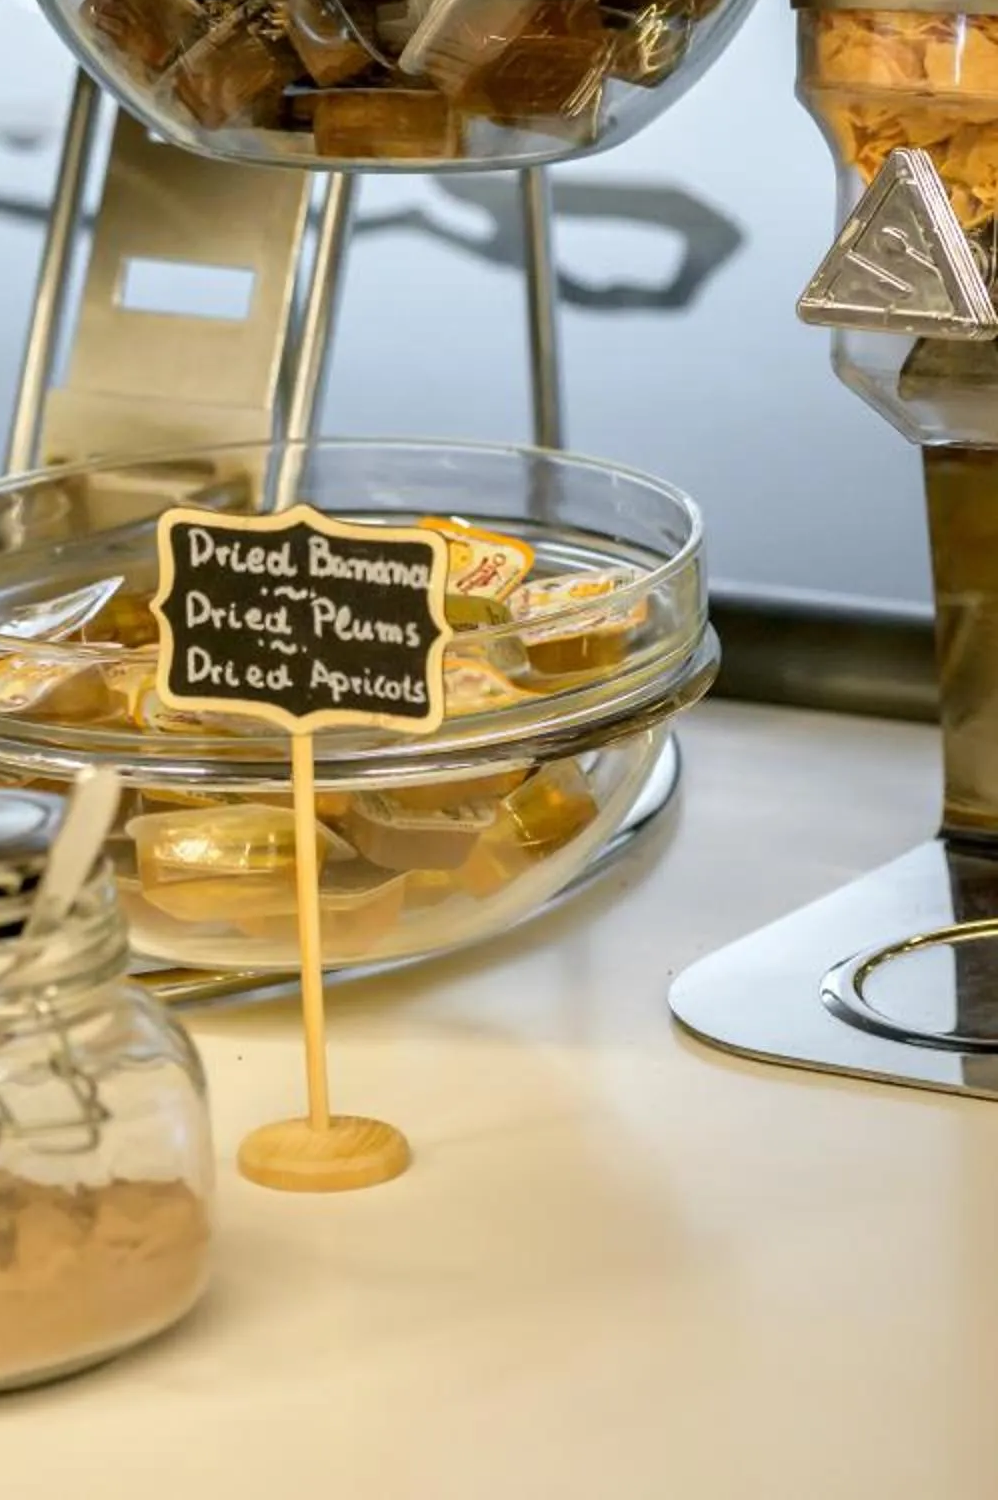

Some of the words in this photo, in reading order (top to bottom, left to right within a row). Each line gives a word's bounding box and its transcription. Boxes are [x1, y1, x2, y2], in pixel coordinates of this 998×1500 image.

[188, 528, 297, 577] Dried
[308, 535, 430, 589] Banana
[186, 591, 292, 635] Dried
[311, 597, 421, 647] Plums
[187, 646, 293, 690] Dried
[310, 659, 427, 703] Apricots
